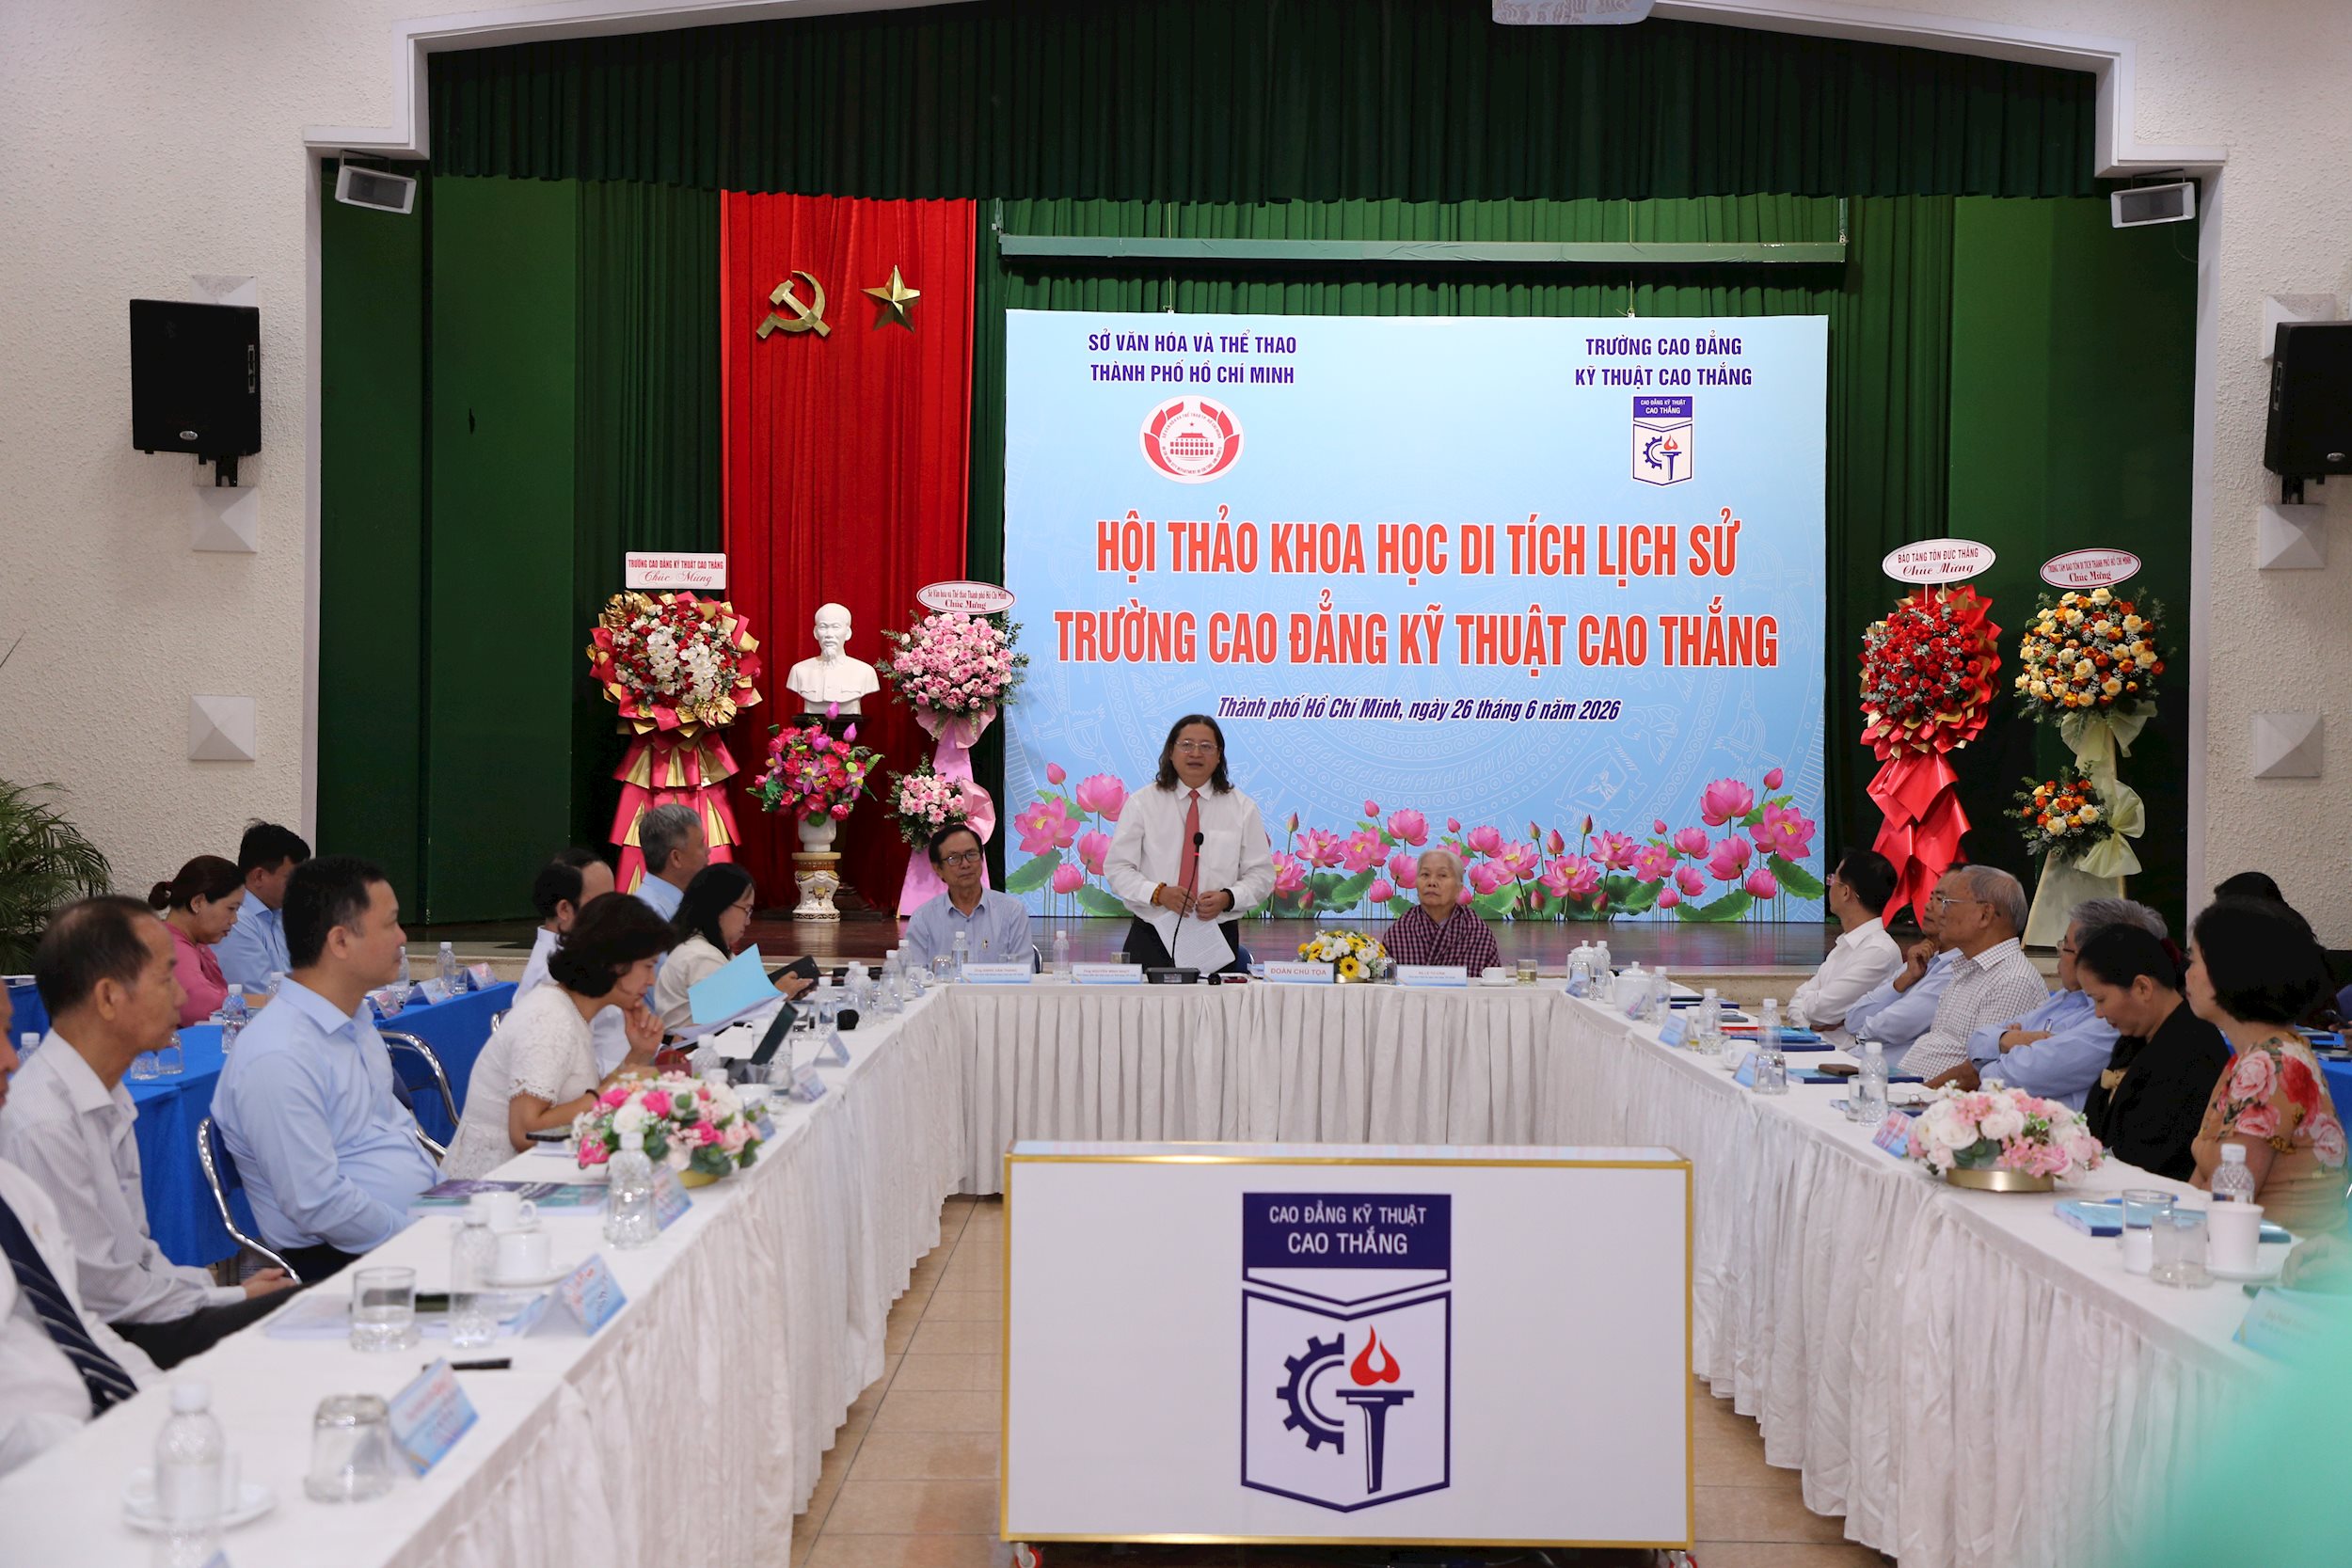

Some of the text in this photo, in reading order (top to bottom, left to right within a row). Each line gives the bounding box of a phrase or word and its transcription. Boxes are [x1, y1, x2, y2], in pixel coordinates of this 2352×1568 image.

[1089, 328, 1296, 353] SỞ VĂN HÓA VÀ THỂ THAO
[1586, 330, 1741, 356] TRƯỜNG CAO ĐẲNG
[1090, 359, 1295, 384] THÀNH PHỐ HỒ CHÍ MINH
[1575, 362, 1752, 389] KỸ THUẬT CAO THẮNG
[1097, 505, 1740, 587] HỘI THẢO KHOA HỌC DI TÍCH LỊCH SỬ
[1055, 589, 1778, 677] TRƯỜNG CAO ĐẲNG KỸ THUẬT CAO THẮNG
[1217, 694, 1621, 721] Thành phố Hồ Chí Minh, ngày 26 tháng 6 năm 2026
[1269, 1200, 1427, 1227] CAO ĐẲNG KỸ THUẬT
[1287, 1226, 1407, 1255] CAO THẮNG
